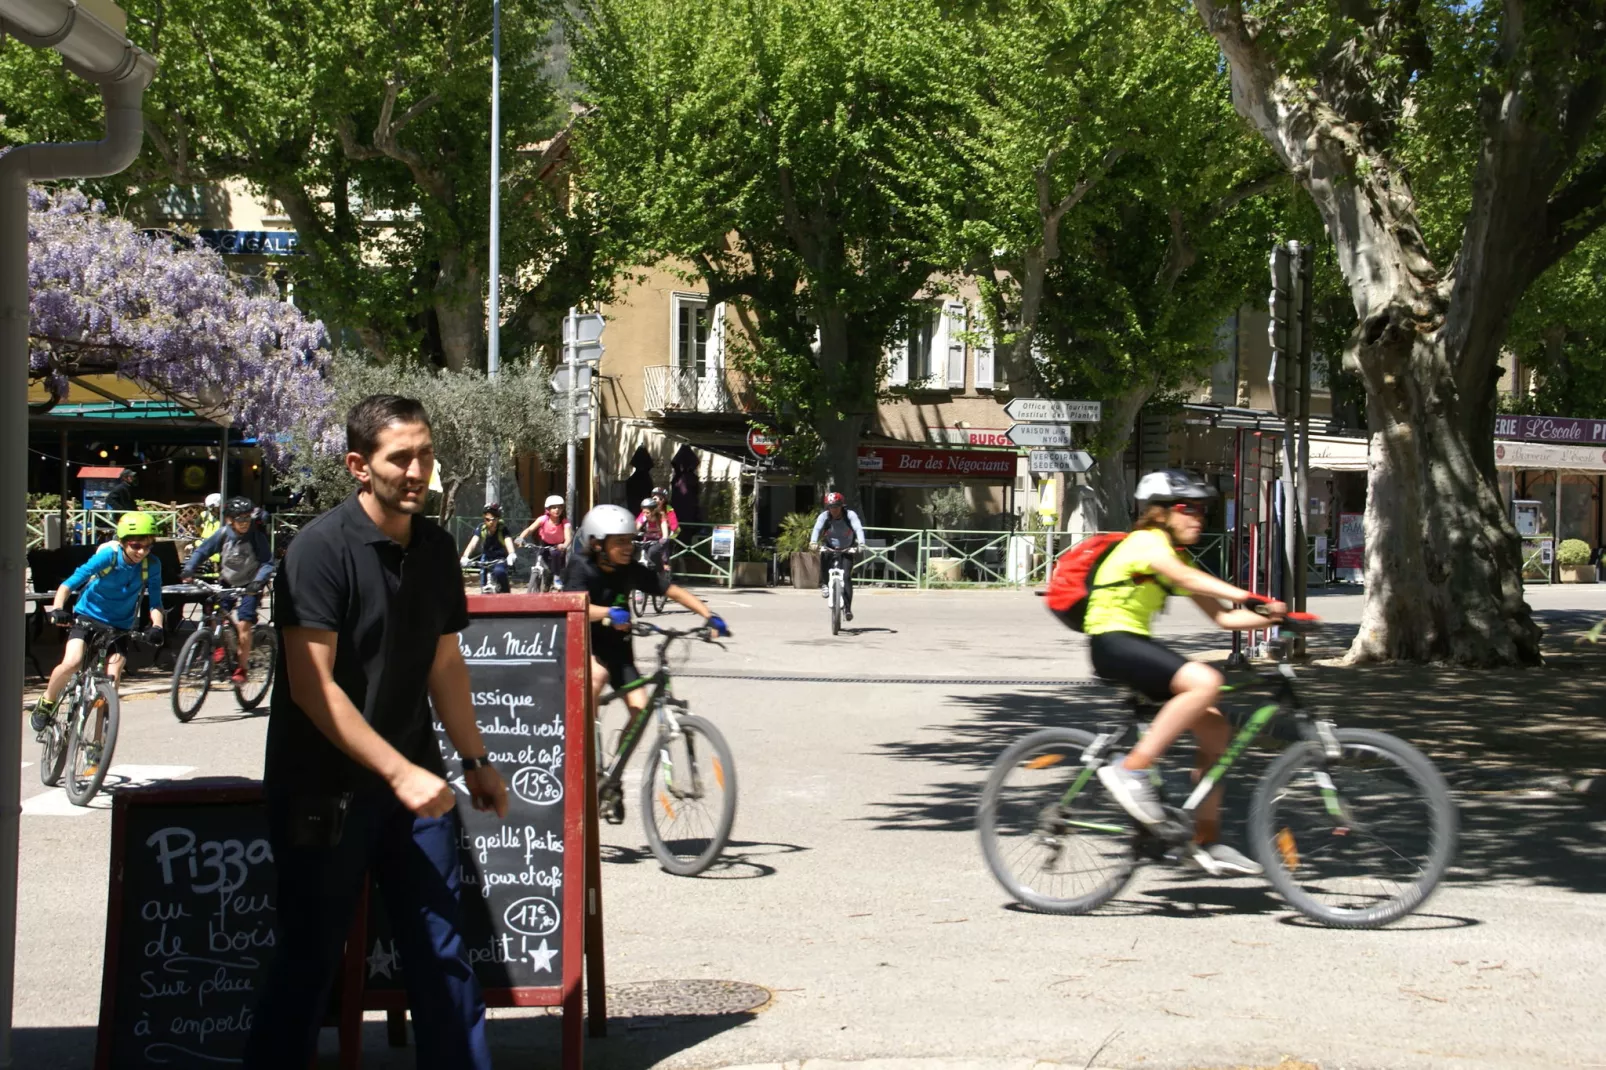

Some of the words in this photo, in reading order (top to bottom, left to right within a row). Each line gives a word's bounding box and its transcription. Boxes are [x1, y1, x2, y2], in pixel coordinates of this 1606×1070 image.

[1022, 402, 1046, 410] Office
[1066, 403, 1099, 411] Tourisme
[1020, 427, 1050, 435] VAISON
[1042, 436, 1069, 444] NYONS
[1523, 417, 1581, 440] L'Escale
[898, 454, 922, 470] Bar
[924, 458, 943, 470] des
[946, 455, 1010, 473] Négociants
[1033, 453, 1079, 461] VERCOIRAN
[473, 635, 497, 657] du
[487, 751, 517, 763] our
[518, 745, 536, 764] et
[474, 825, 521, 864] grillé
[524, 826, 564, 865] frites
[146, 827, 275, 893] Pizza
[482, 870, 520, 898] jour
[520, 865, 534, 885] et
[142, 900, 192, 921] au
[213, 878, 276, 932] feu
[144, 922, 189, 957] de
[209, 920, 276, 951] bois
[139, 970, 192, 998] Sur
[198, 966, 254, 1007] place
[133, 1011, 151, 1036] à
